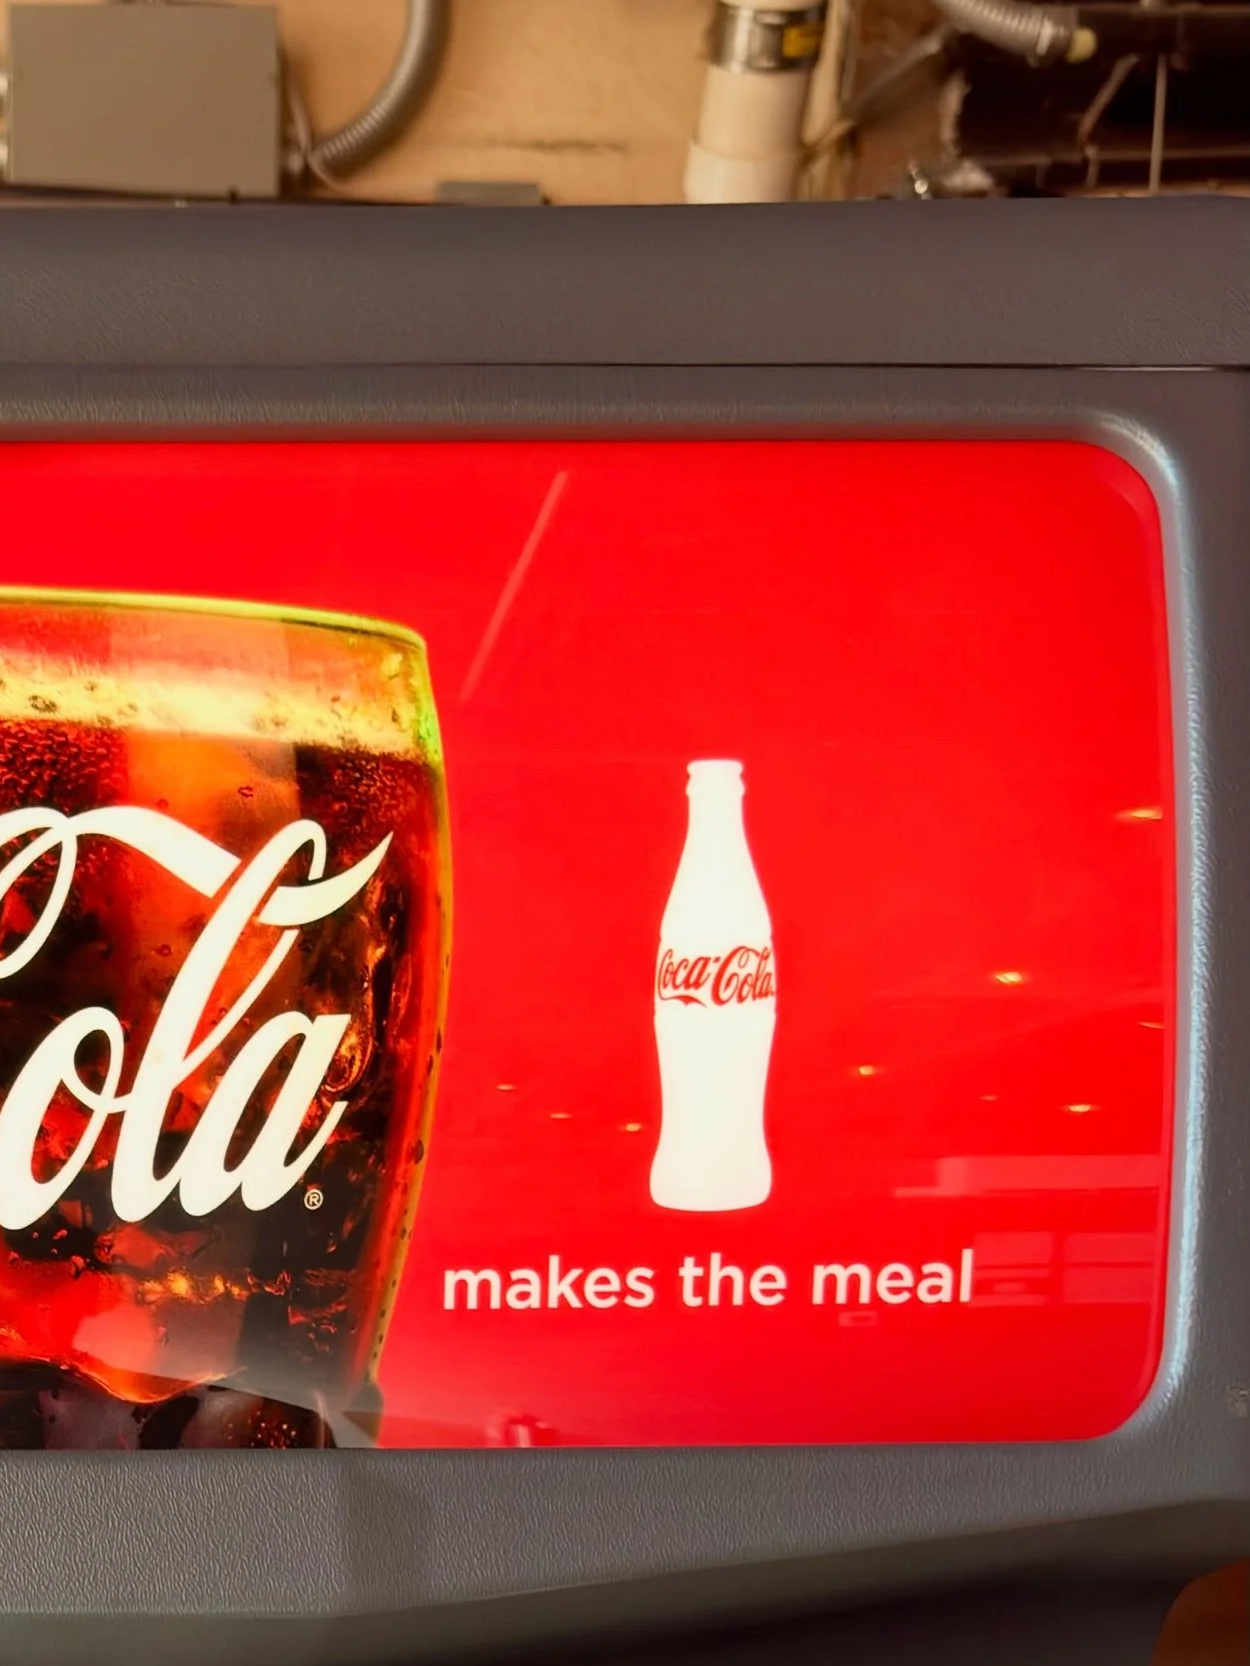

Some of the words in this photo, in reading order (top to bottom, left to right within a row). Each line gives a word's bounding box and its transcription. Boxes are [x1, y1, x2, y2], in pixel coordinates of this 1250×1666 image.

[658, 945, 772, 1008] Coca-Cola
[443, 1255, 655, 1311] makes
[678, 1252, 788, 1307] the
[811, 1248, 975, 1305] meal
